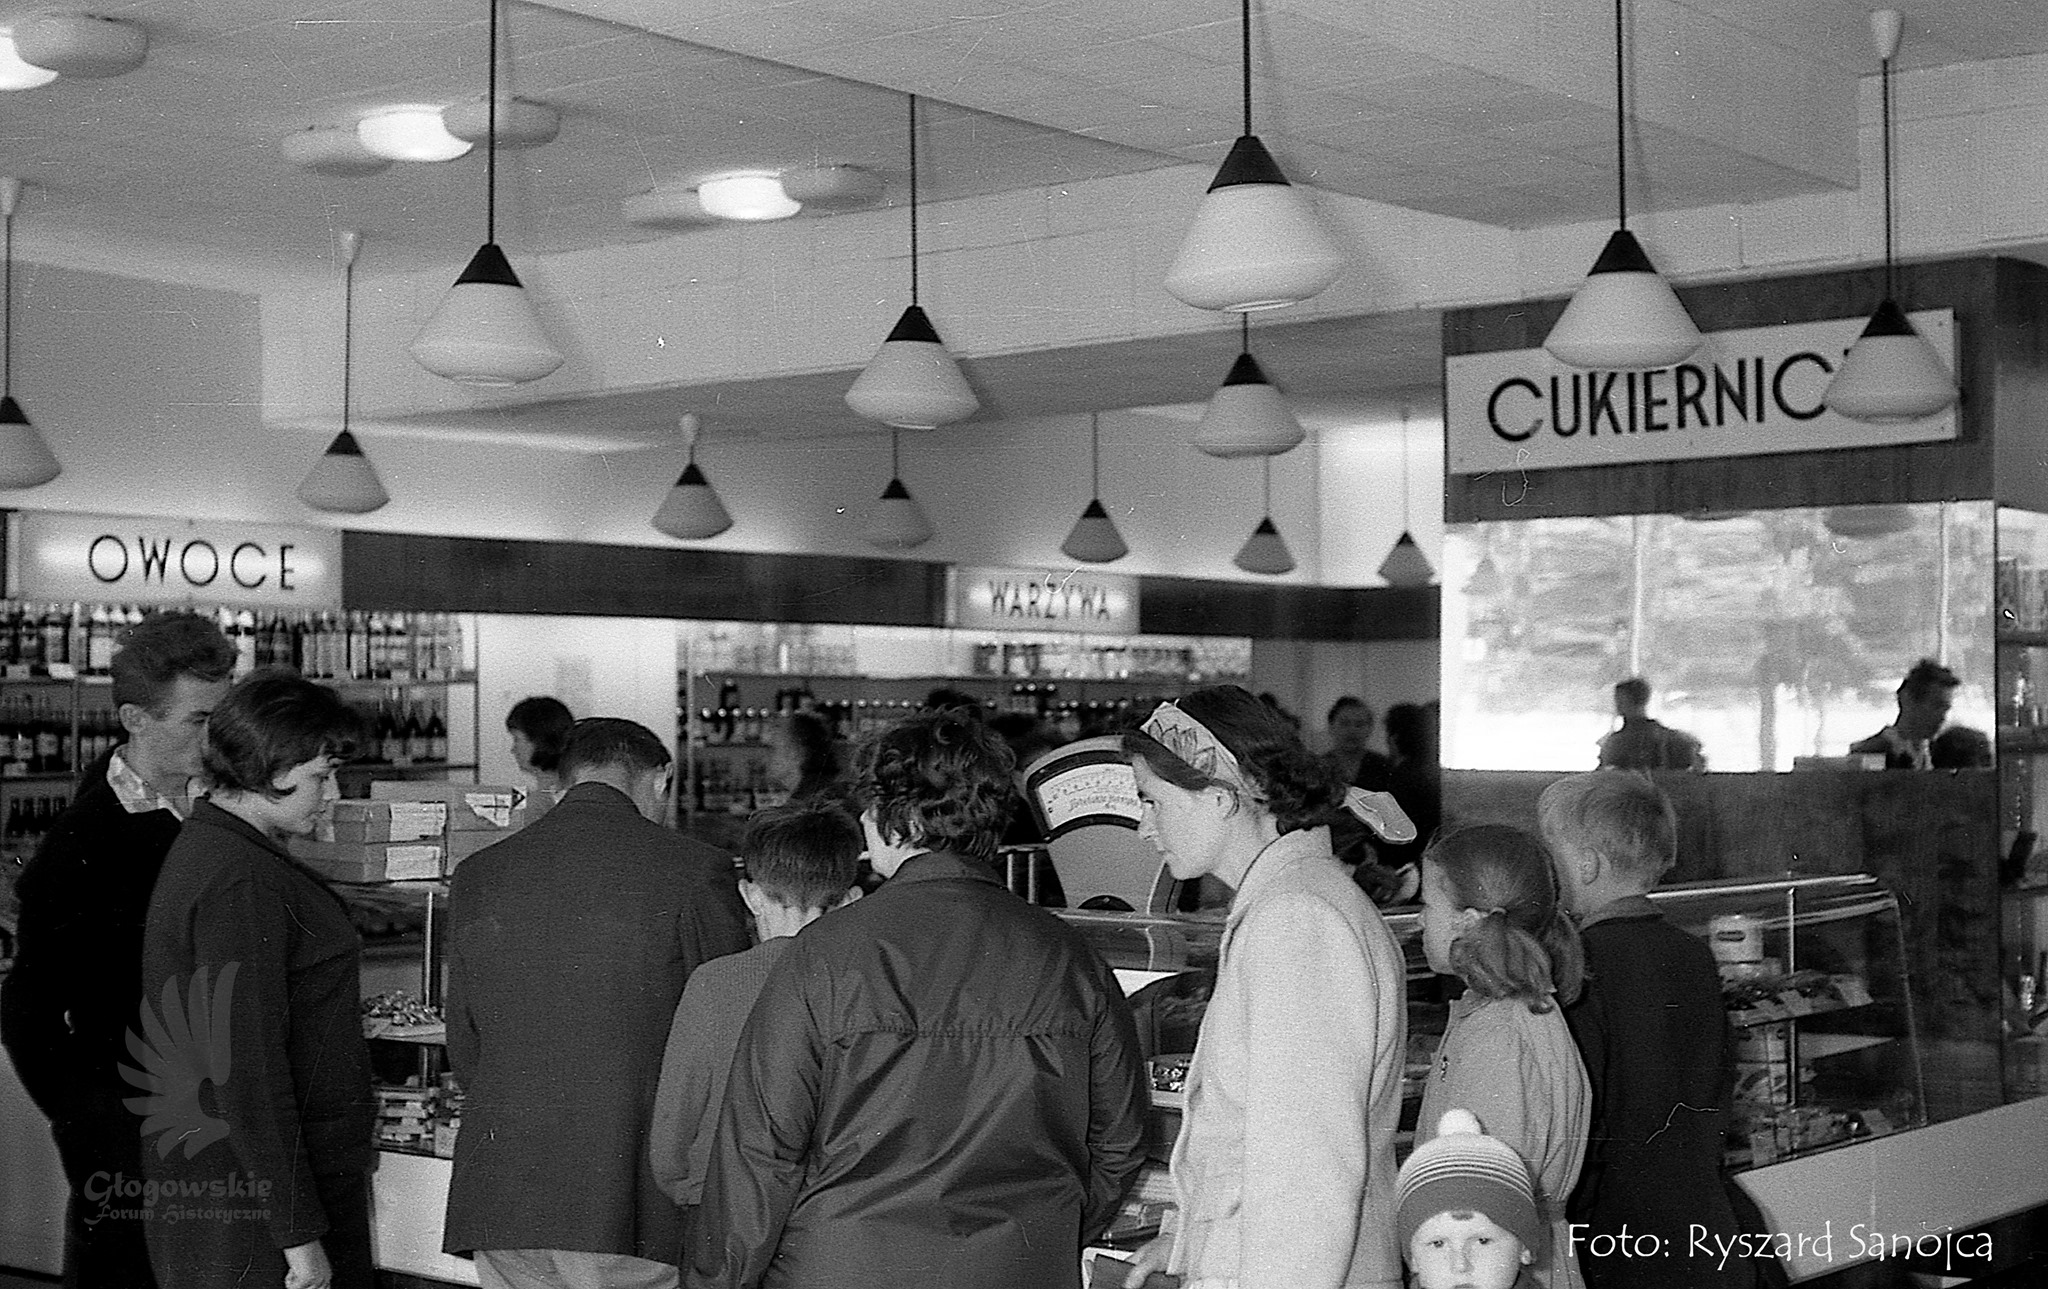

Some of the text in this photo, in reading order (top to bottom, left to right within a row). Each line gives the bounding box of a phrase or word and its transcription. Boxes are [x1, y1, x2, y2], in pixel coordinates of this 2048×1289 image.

[1487, 348, 1851, 442] CUKIERNIC
[89, 534, 295, 590] OWOCE
[989, 580, 1110, 620] WARZYWA
